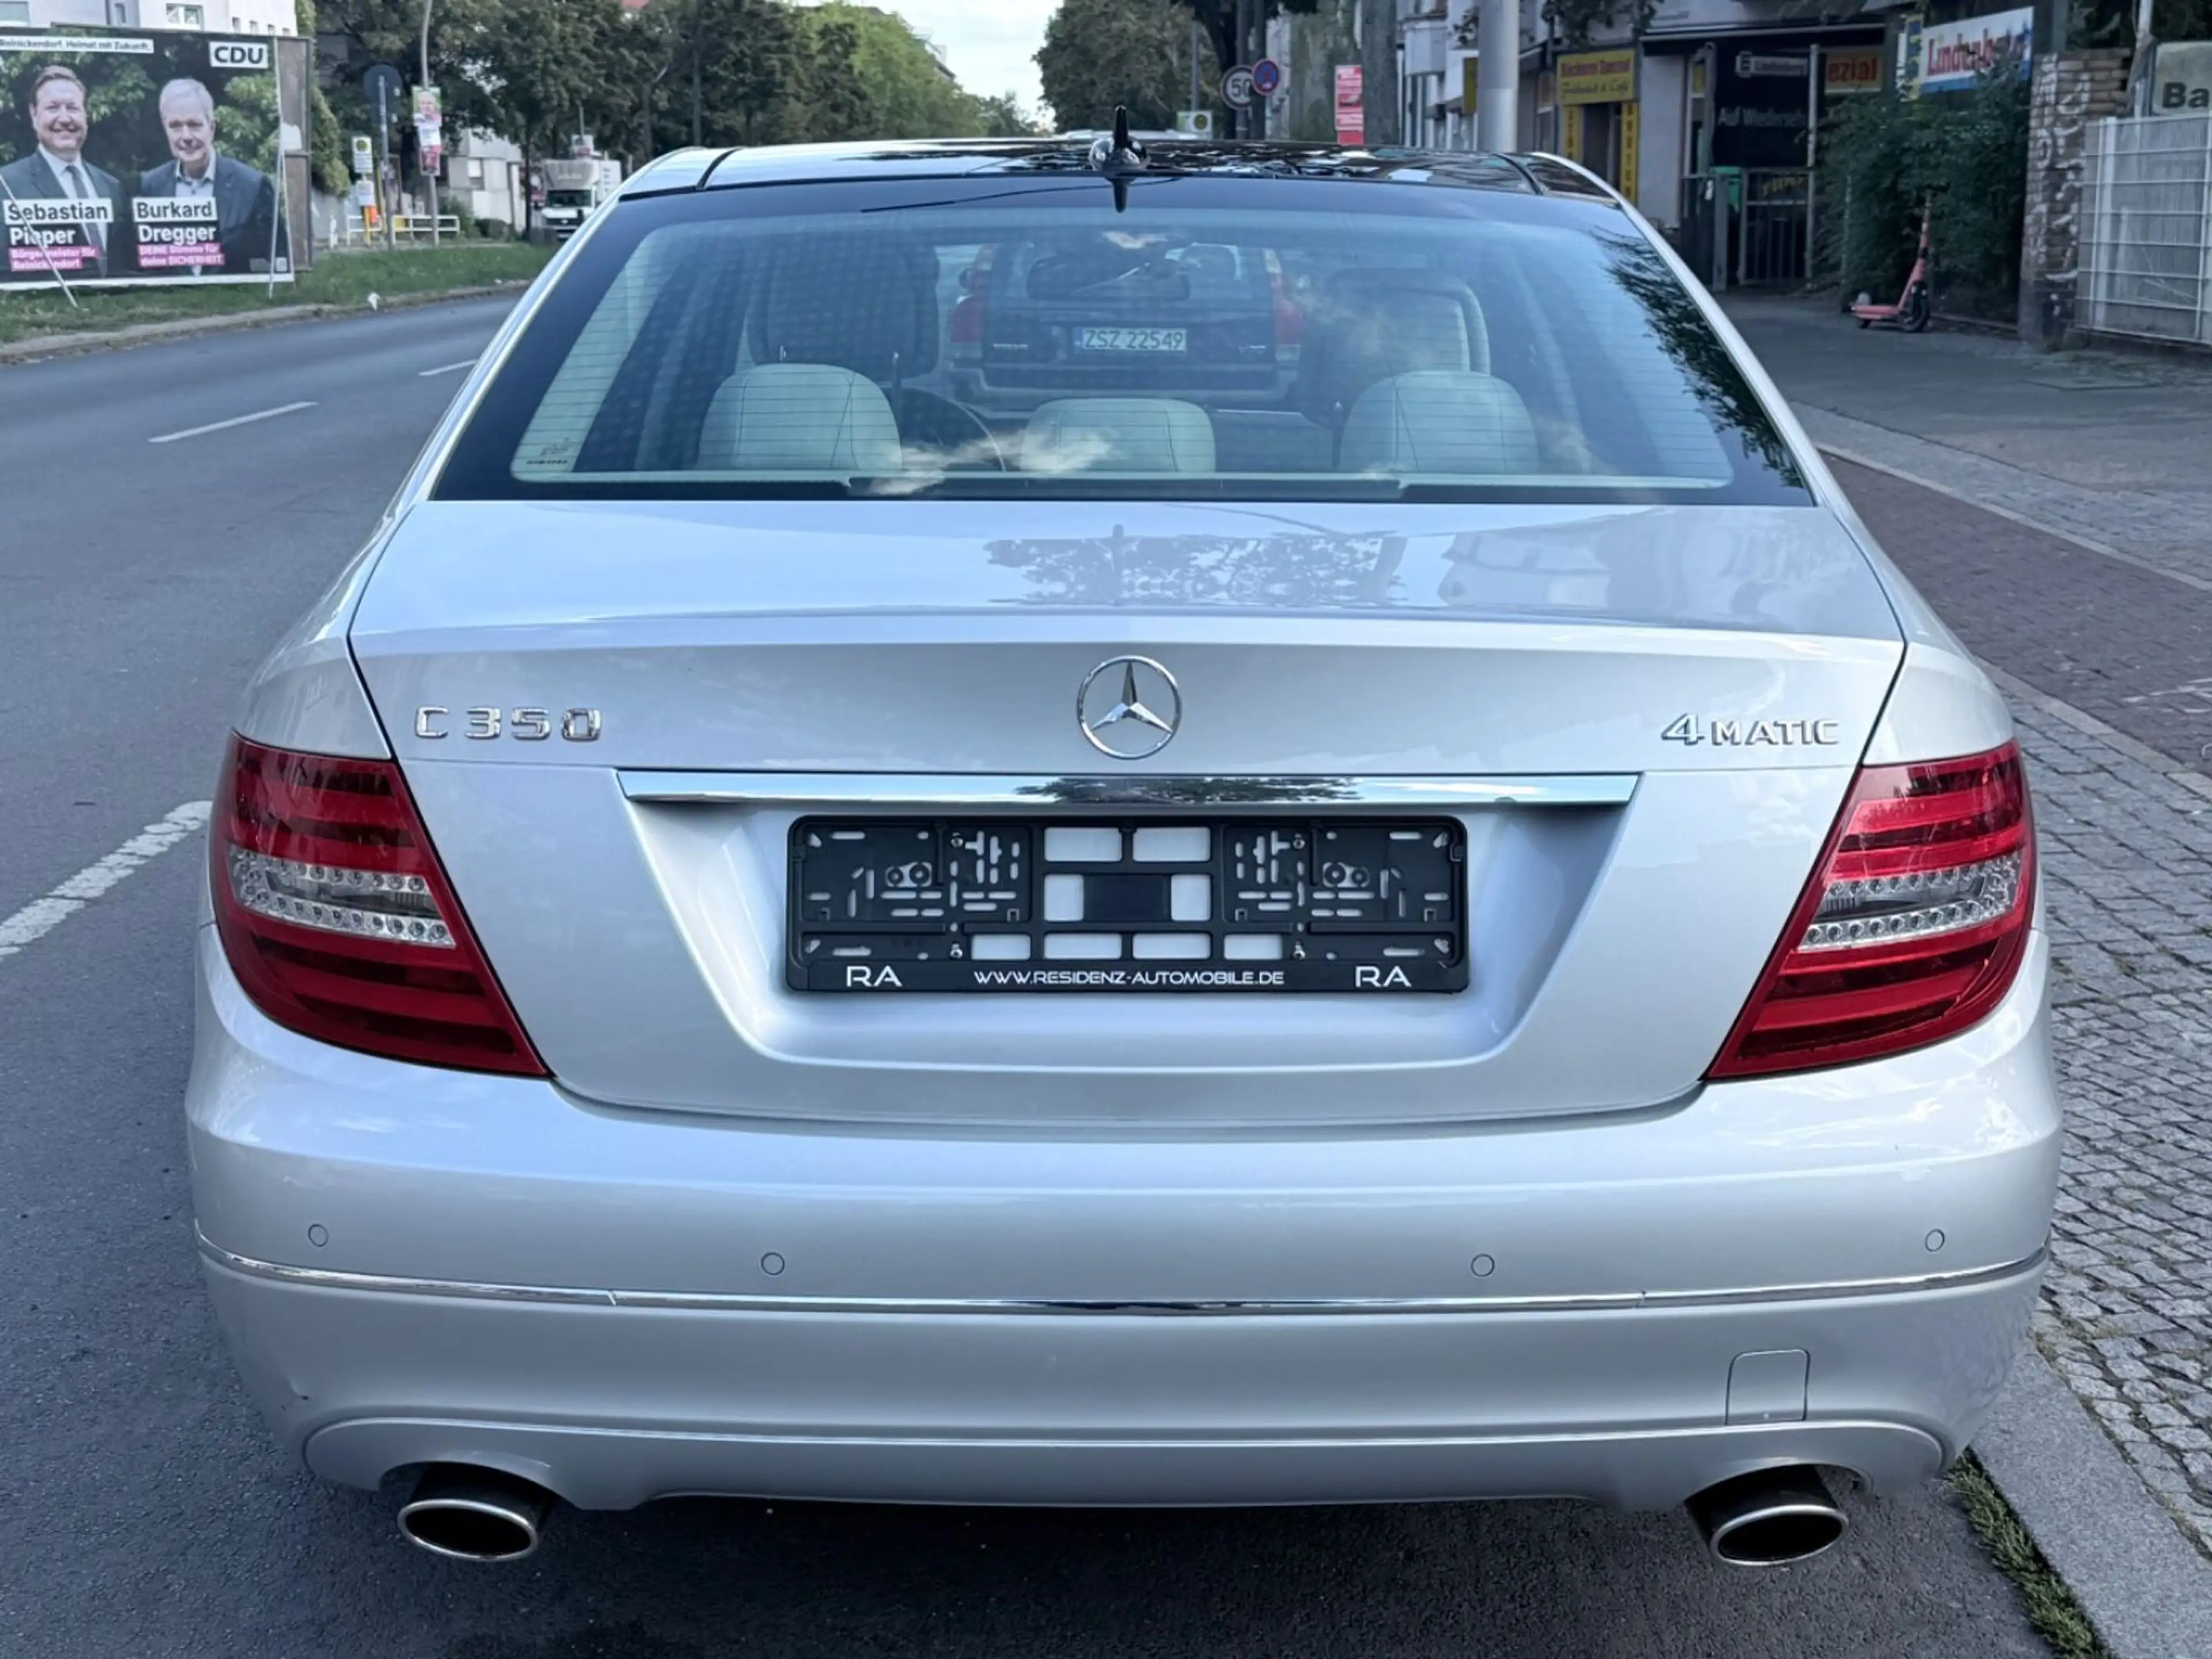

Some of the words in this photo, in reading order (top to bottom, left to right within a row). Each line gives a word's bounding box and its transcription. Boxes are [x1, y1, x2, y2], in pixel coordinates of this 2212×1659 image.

[214, 46, 263, 65] CDU
[1230, 78, 1252, 98] 50
[2162, 82, 2210, 109] Ba
[8, 202, 108, 221] Sebastian
[137, 201, 212, 218] Burkard
[138, 225, 216, 245] Dregger
[1085, 329, 1120, 348] ZSZ
[1126, 331, 1184, 350] 22549
[414, 704, 449, 740] C
[464, 706, 603, 742] 350
[846, 964, 903, 988] RA
[974, 970, 1285, 986] WWW.RESIDENZ-AUTOMOBILE.DE
[1355, 964, 1412, 988] RA
